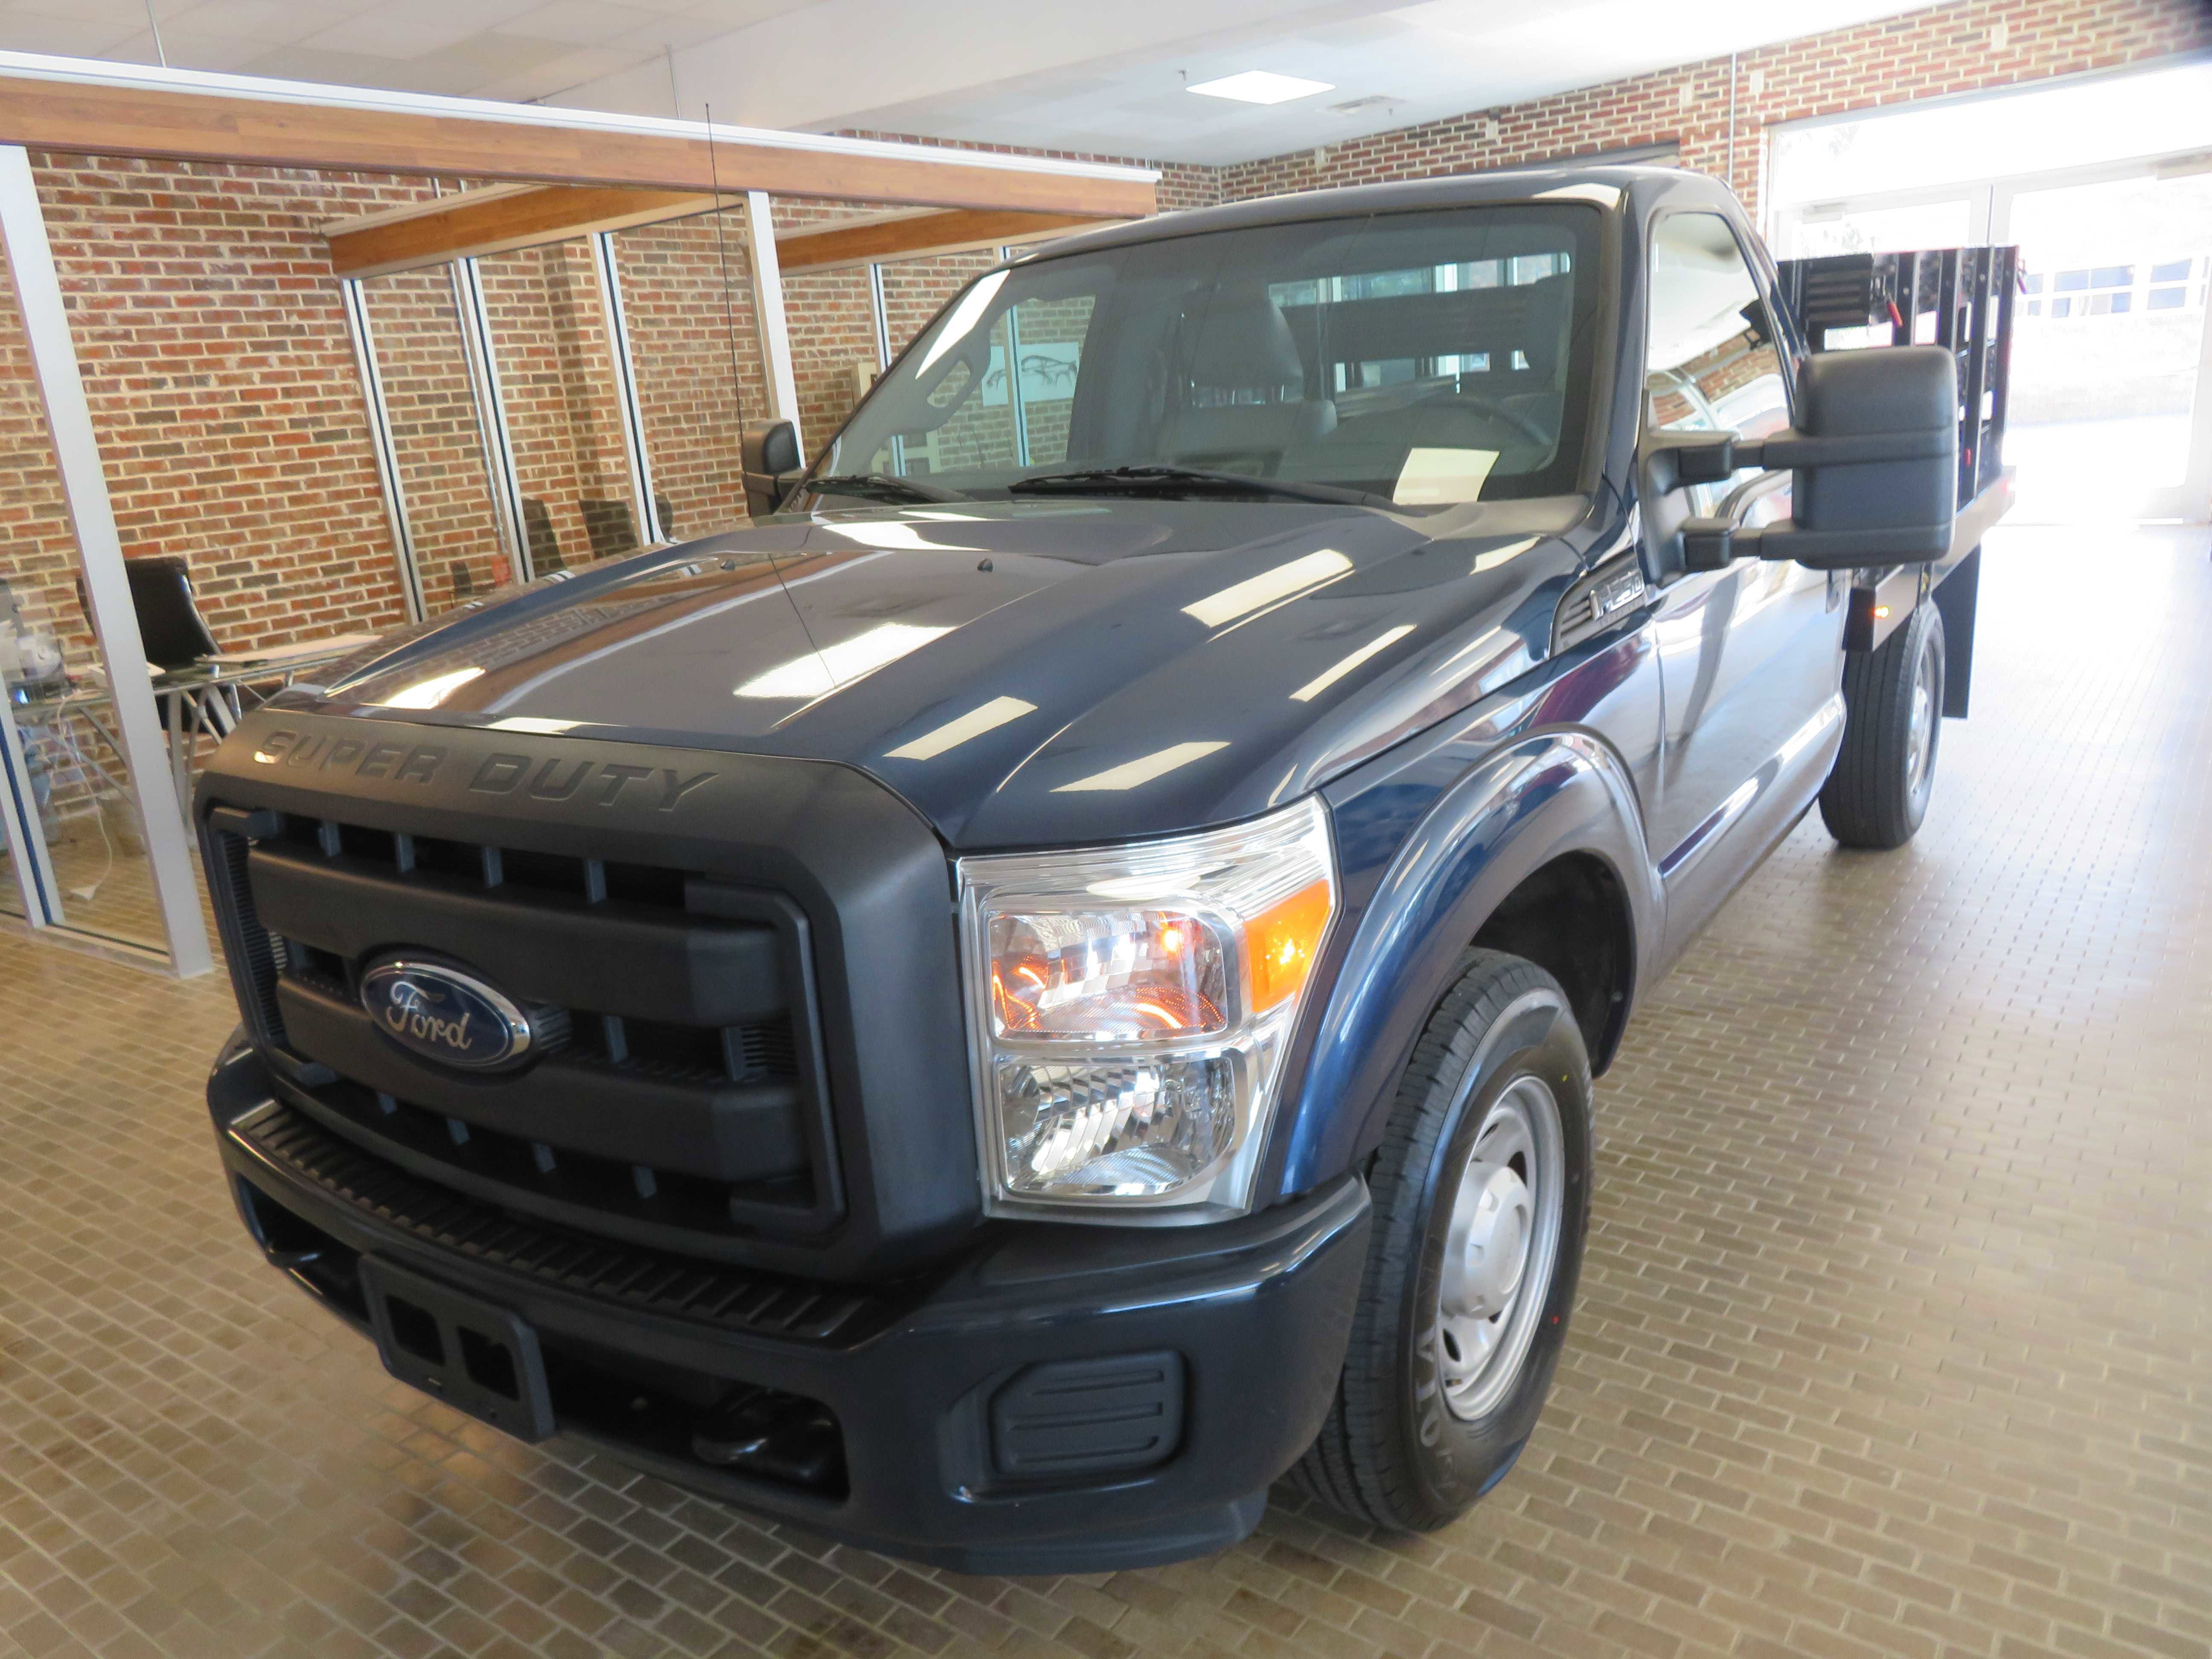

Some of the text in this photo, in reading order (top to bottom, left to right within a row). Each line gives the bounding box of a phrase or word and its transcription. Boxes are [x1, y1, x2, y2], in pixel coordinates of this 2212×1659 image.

[253, 731, 720, 811] SUPER DUTY
[386, 981, 472, 1050] Ford
